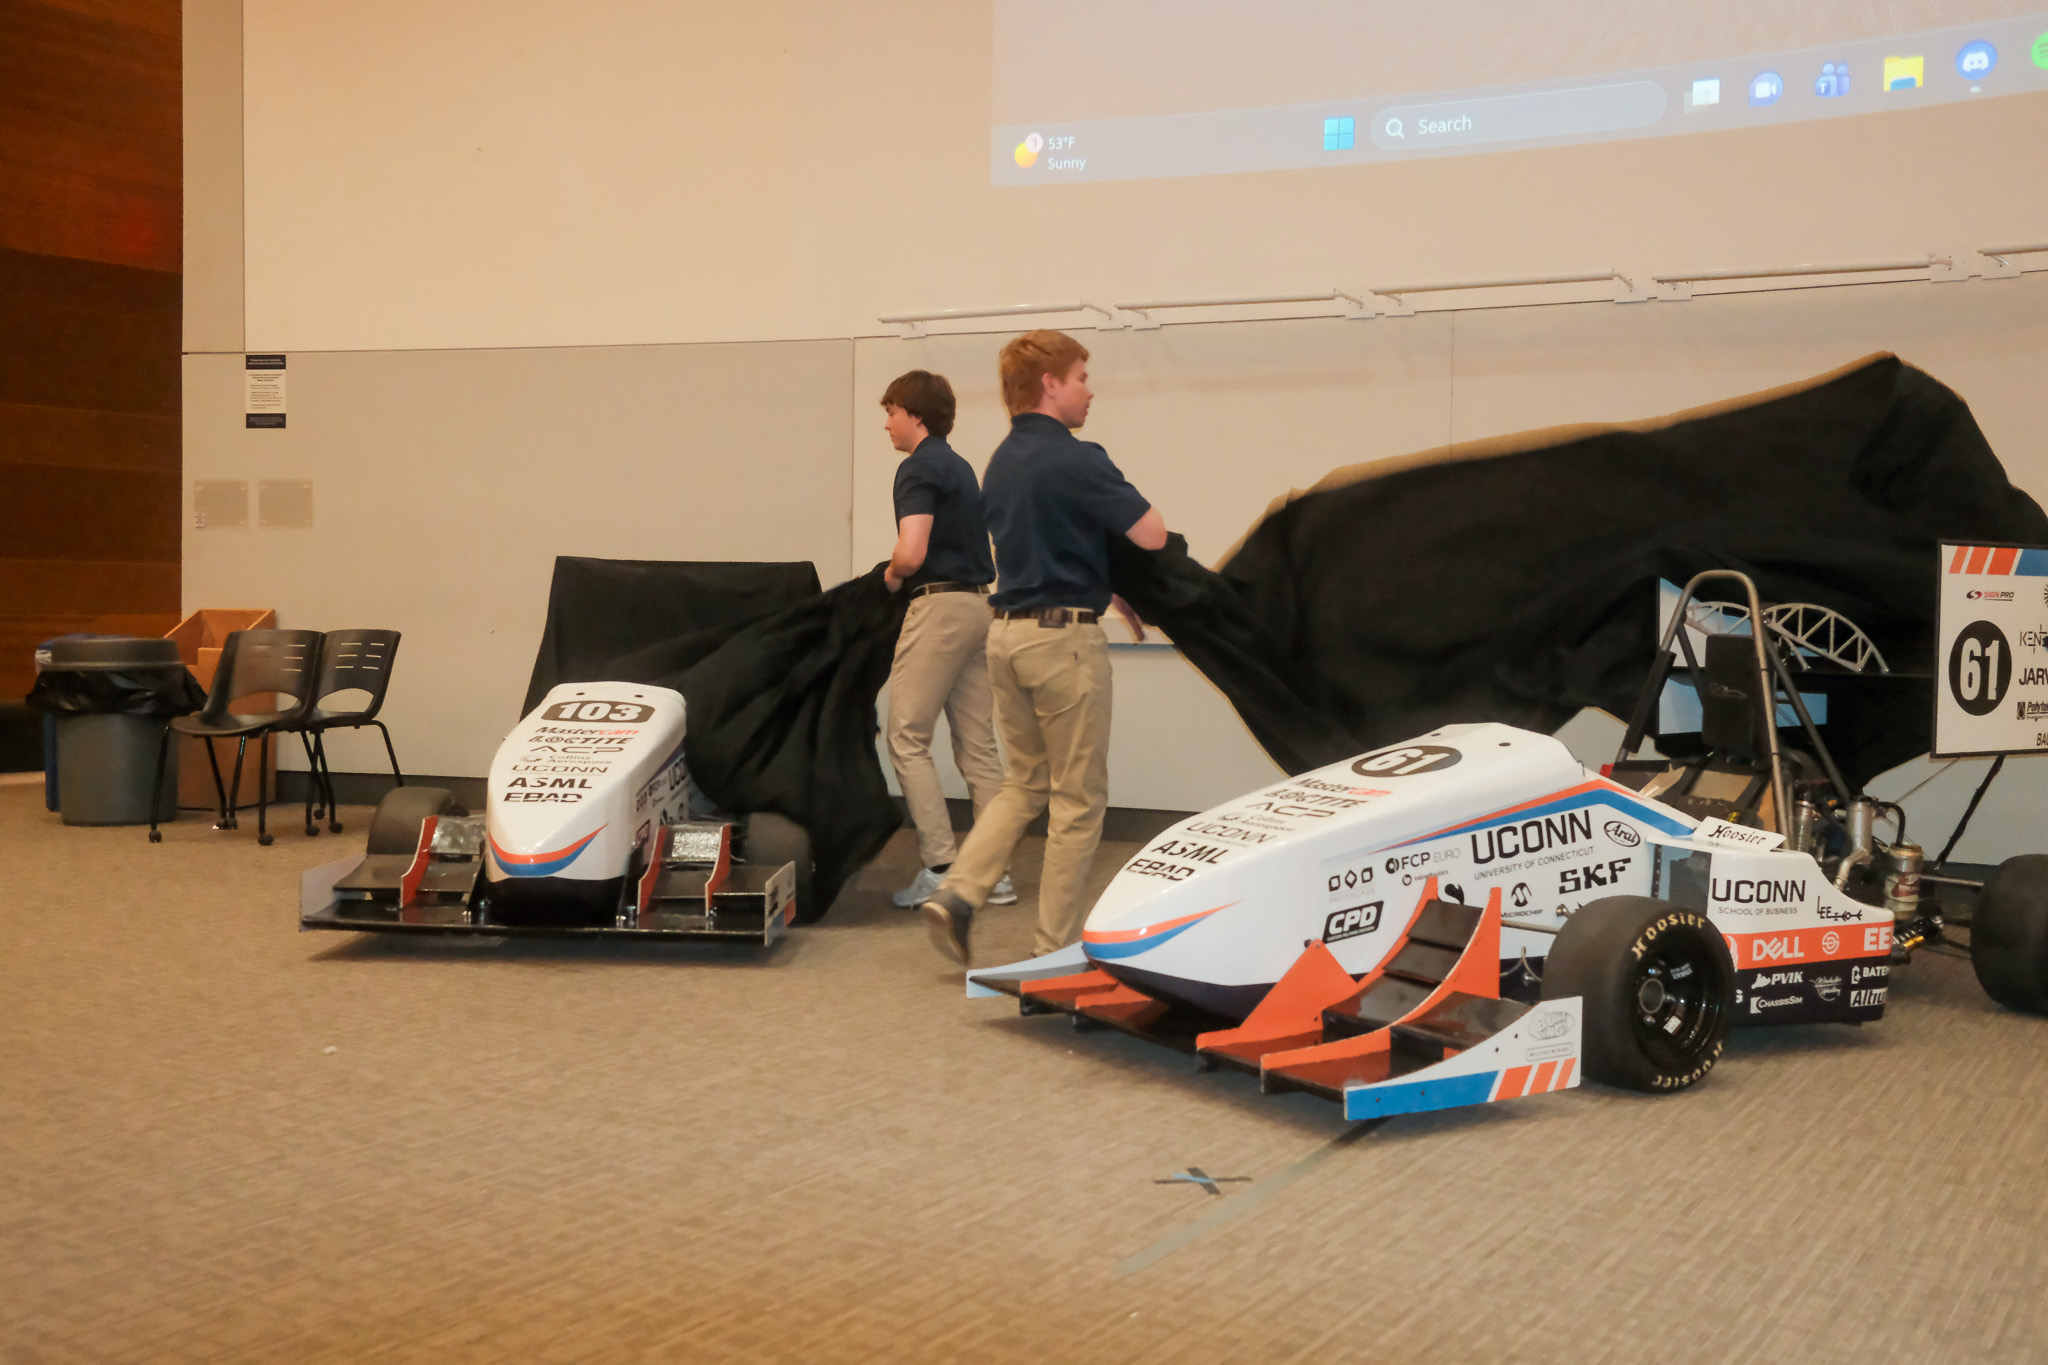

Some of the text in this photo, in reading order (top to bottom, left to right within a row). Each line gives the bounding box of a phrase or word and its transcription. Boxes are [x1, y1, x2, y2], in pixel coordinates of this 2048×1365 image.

[1418, 114, 1472, 135] Search
[1048, 136, 1076, 150] 53°F
[1047, 157, 1087, 172] Sunny
[2000, 591, 2014, 599] PRO
[1960, 637, 2000, 701] 61
[558, 702, 643, 721] 103
[528, 735, 634, 744] LOCTITE
[535, 726, 639, 735] Mastercam
[530, 745, 624, 754] ACP
[512, 765, 608, 773] UCONN
[1361, 748, 1450, 775] 61
[507, 777, 593, 789] ASML
[503, 792, 583, 803] EBAD
[1245, 802, 1336, 818] ACP
[1186, 821, 1277, 844] UCONN
[1471, 809, 1592, 865] UCONN
[1708, 824, 1767, 845] Hoosier
[1151, 840, 1229, 864] ASML
[1401, 848, 1460, 870] FCP EURO
[1474, 846, 1594, 881] UNIVERSITY OF CONNECTICUT
[1559, 857, 1632, 895] SKF
[1711, 877, 1806, 904] UCONN
[1328, 905, 1378, 935] CPD
[1718, 906, 1798, 916] SCHOOL OF BUSINESS
[1752, 936, 1805, 962] DELL
